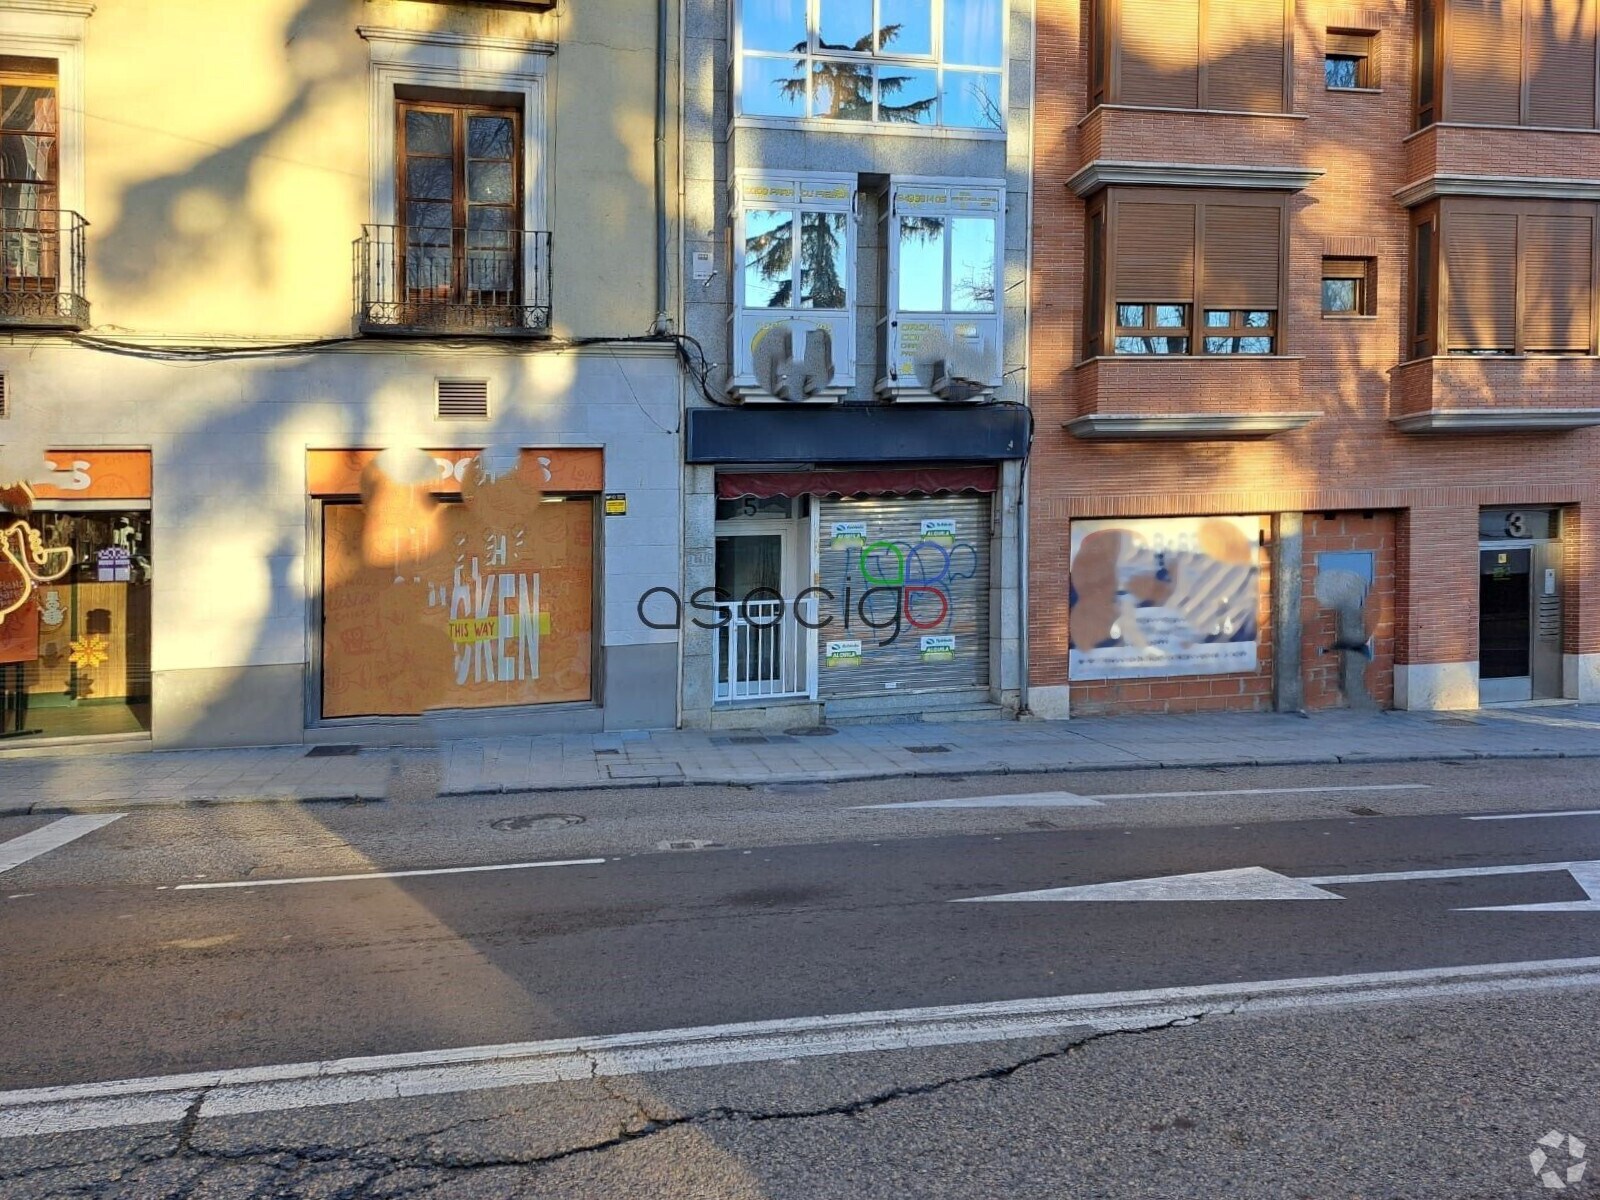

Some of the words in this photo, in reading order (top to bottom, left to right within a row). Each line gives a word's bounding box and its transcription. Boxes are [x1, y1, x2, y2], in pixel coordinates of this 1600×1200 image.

[744, 497, 757, 516] 5
[1505, 511, 1524, 538] 3
[450, 622, 469, 638] THIS
[474, 621, 495, 637] WAY
